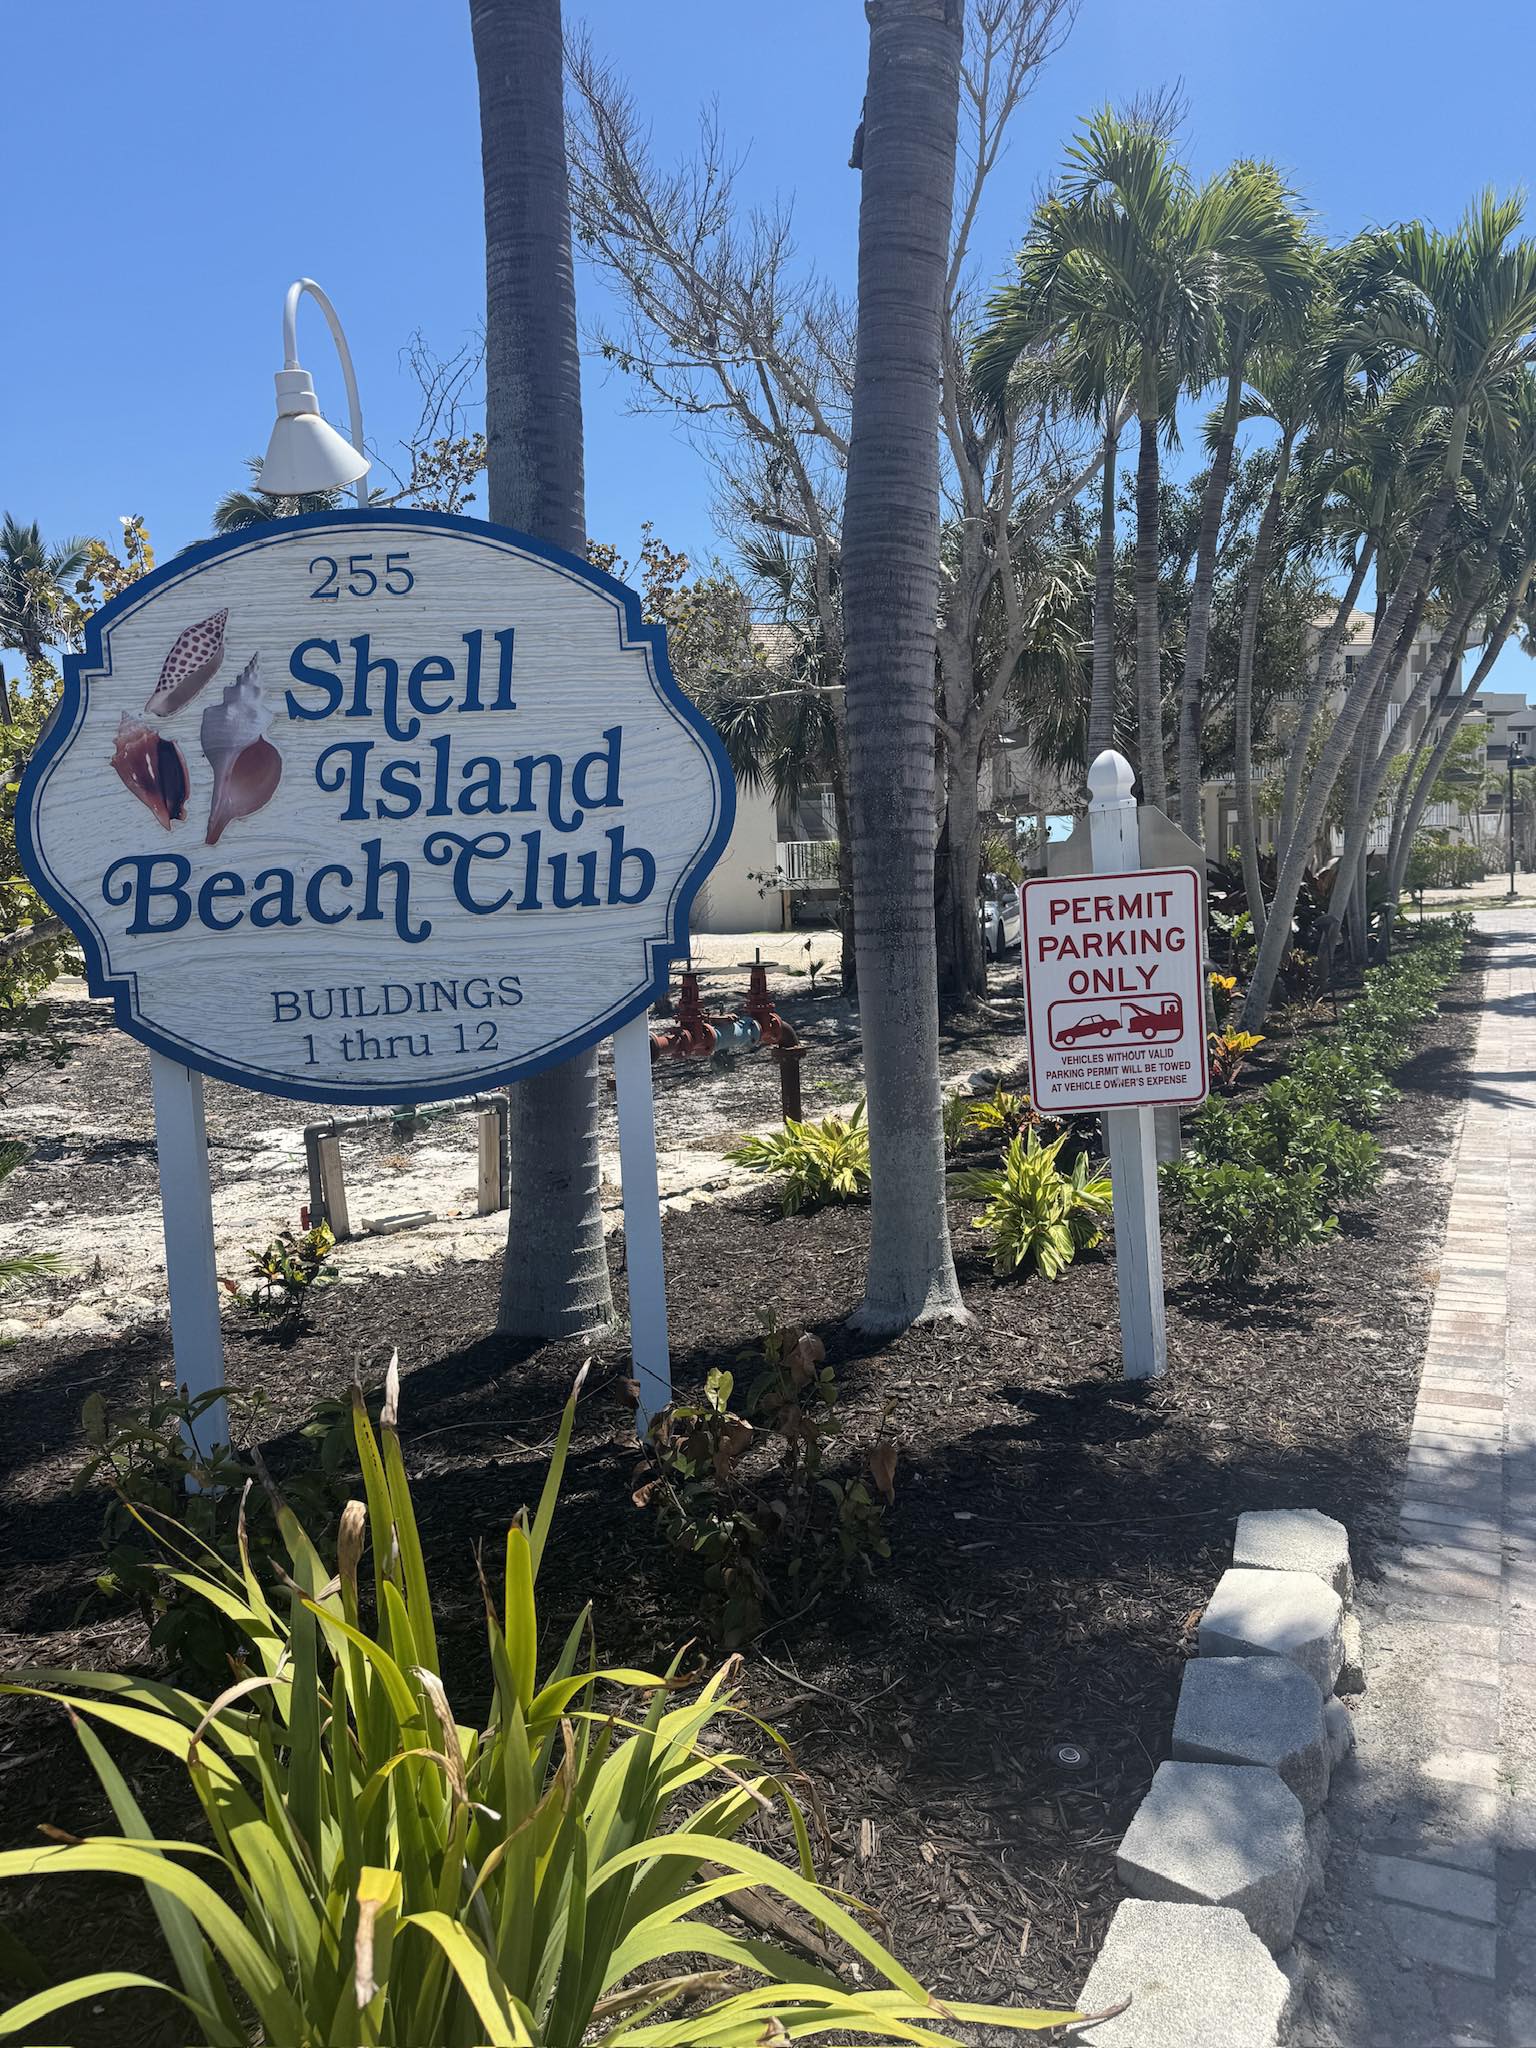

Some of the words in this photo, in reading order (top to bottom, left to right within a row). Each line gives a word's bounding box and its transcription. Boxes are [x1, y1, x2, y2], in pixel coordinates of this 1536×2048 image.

[309, 552, 416, 599] 255
[285, 628, 517, 742] Shell
[315, 725, 624, 832] Island
[101, 839, 433, 944] Beach
[422, 824, 656, 915] Club
[1050, 890, 1174, 925] PERMIT
[1038, 926, 1186, 962] PARKING
[271, 975, 524, 1024] BUILDINGS
[1068, 964, 1159, 995] ONLY
[303, 1032, 320, 1065] 1
[340, 1027, 432, 1062] thru
[453, 1020, 499, 1055] 12
[1061, 1054, 1104, 1065] VEHICLES
[1106, 1050, 1146, 1063] WITHOUT
[1149, 1048, 1174, 1059] VALID
[1046, 1069, 1085, 1080] PARKING
[1087, 1066, 1119, 1077] PERMIT
[1121, 1064, 1143, 1075] WILL
[1144, 1063, 1157, 1073] BE
[1160, 1061, 1191, 1072] TOWED
[1051, 1083, 1062, 1093] AT
[1064, 1080, 1101, 1092] VEHICLE
[1103, 1077, 1145, 1089] OWNER'S
[1147, 1074, 1187, 1087] EXPENSE
